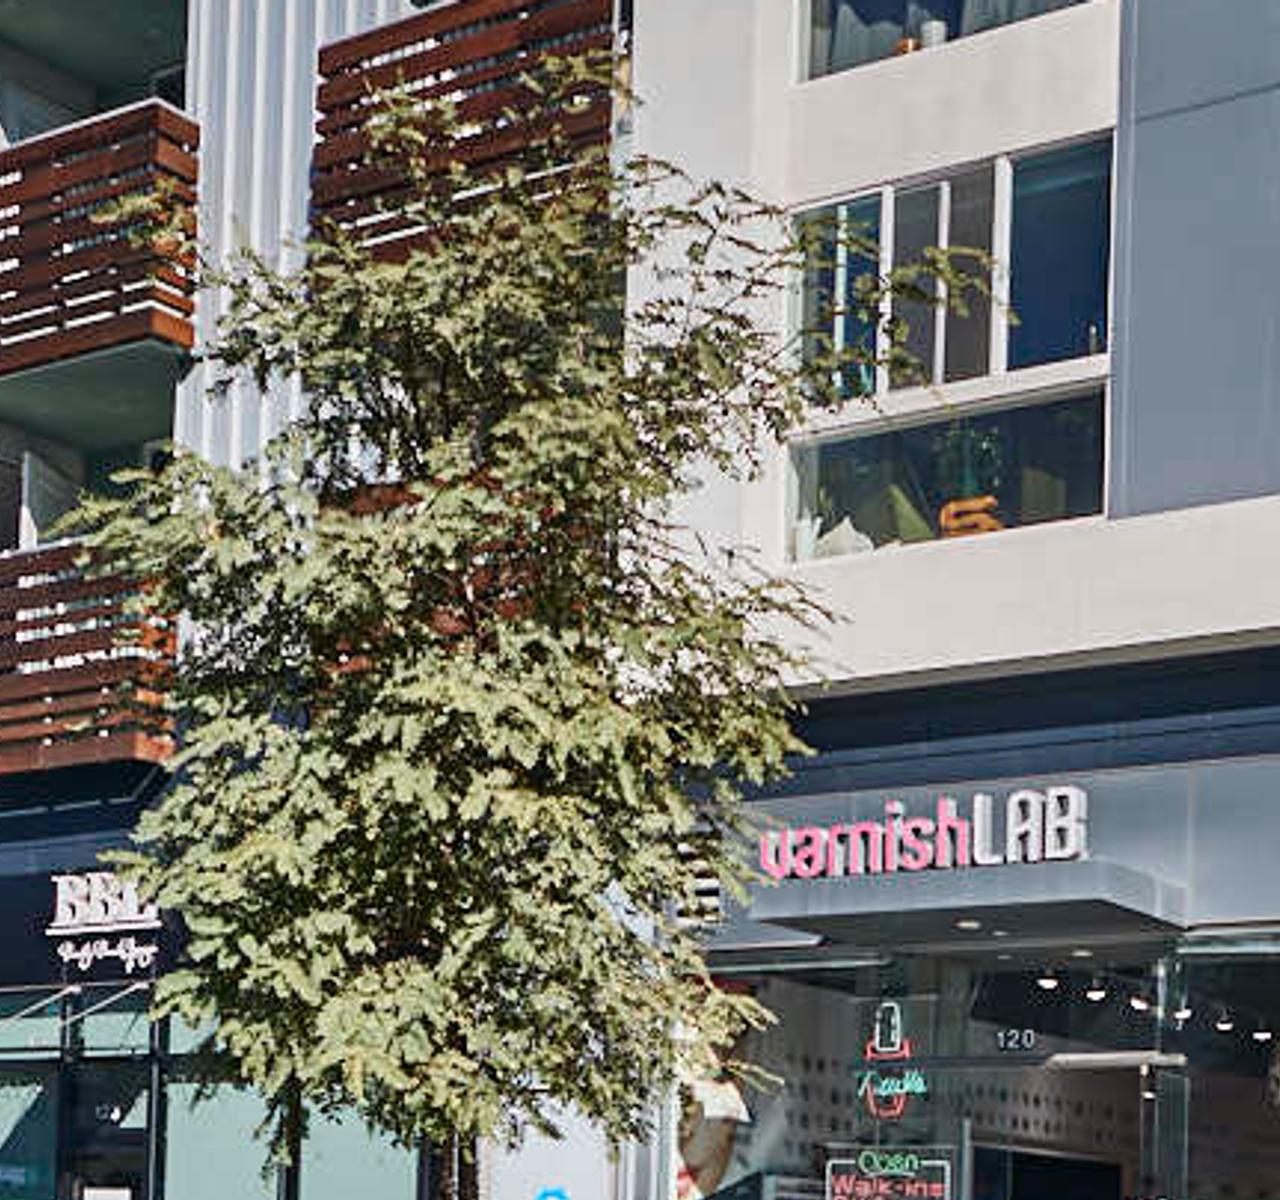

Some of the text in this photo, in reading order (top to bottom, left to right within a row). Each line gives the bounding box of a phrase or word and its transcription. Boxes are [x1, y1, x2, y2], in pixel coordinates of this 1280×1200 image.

[760, 785, 1088, 879] varnishLAB
[997, 1029, 1036, 1048] 120
[858, 1150, 920, 1176] Open
[831, 1174, 945, 1198] Walk-ins
